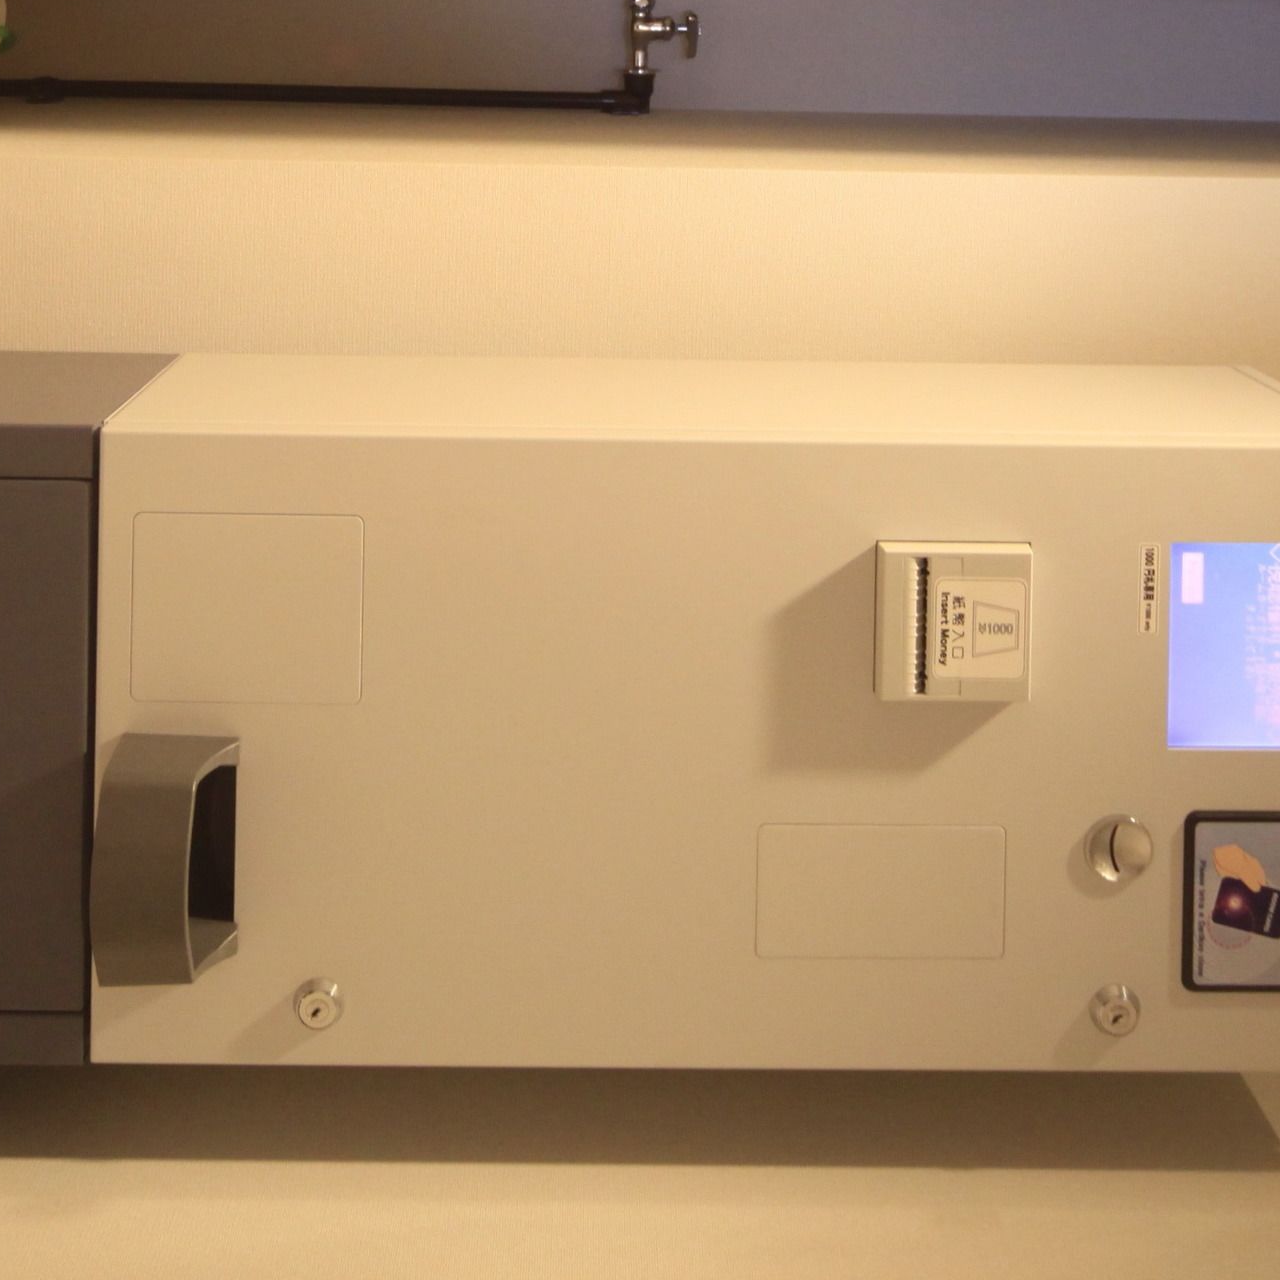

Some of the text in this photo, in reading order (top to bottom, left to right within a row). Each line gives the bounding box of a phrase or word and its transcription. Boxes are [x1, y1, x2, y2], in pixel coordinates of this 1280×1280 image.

[938, 592, 950, 665] Insert Money
[952, 596, 965, 659] 紙幣入口
